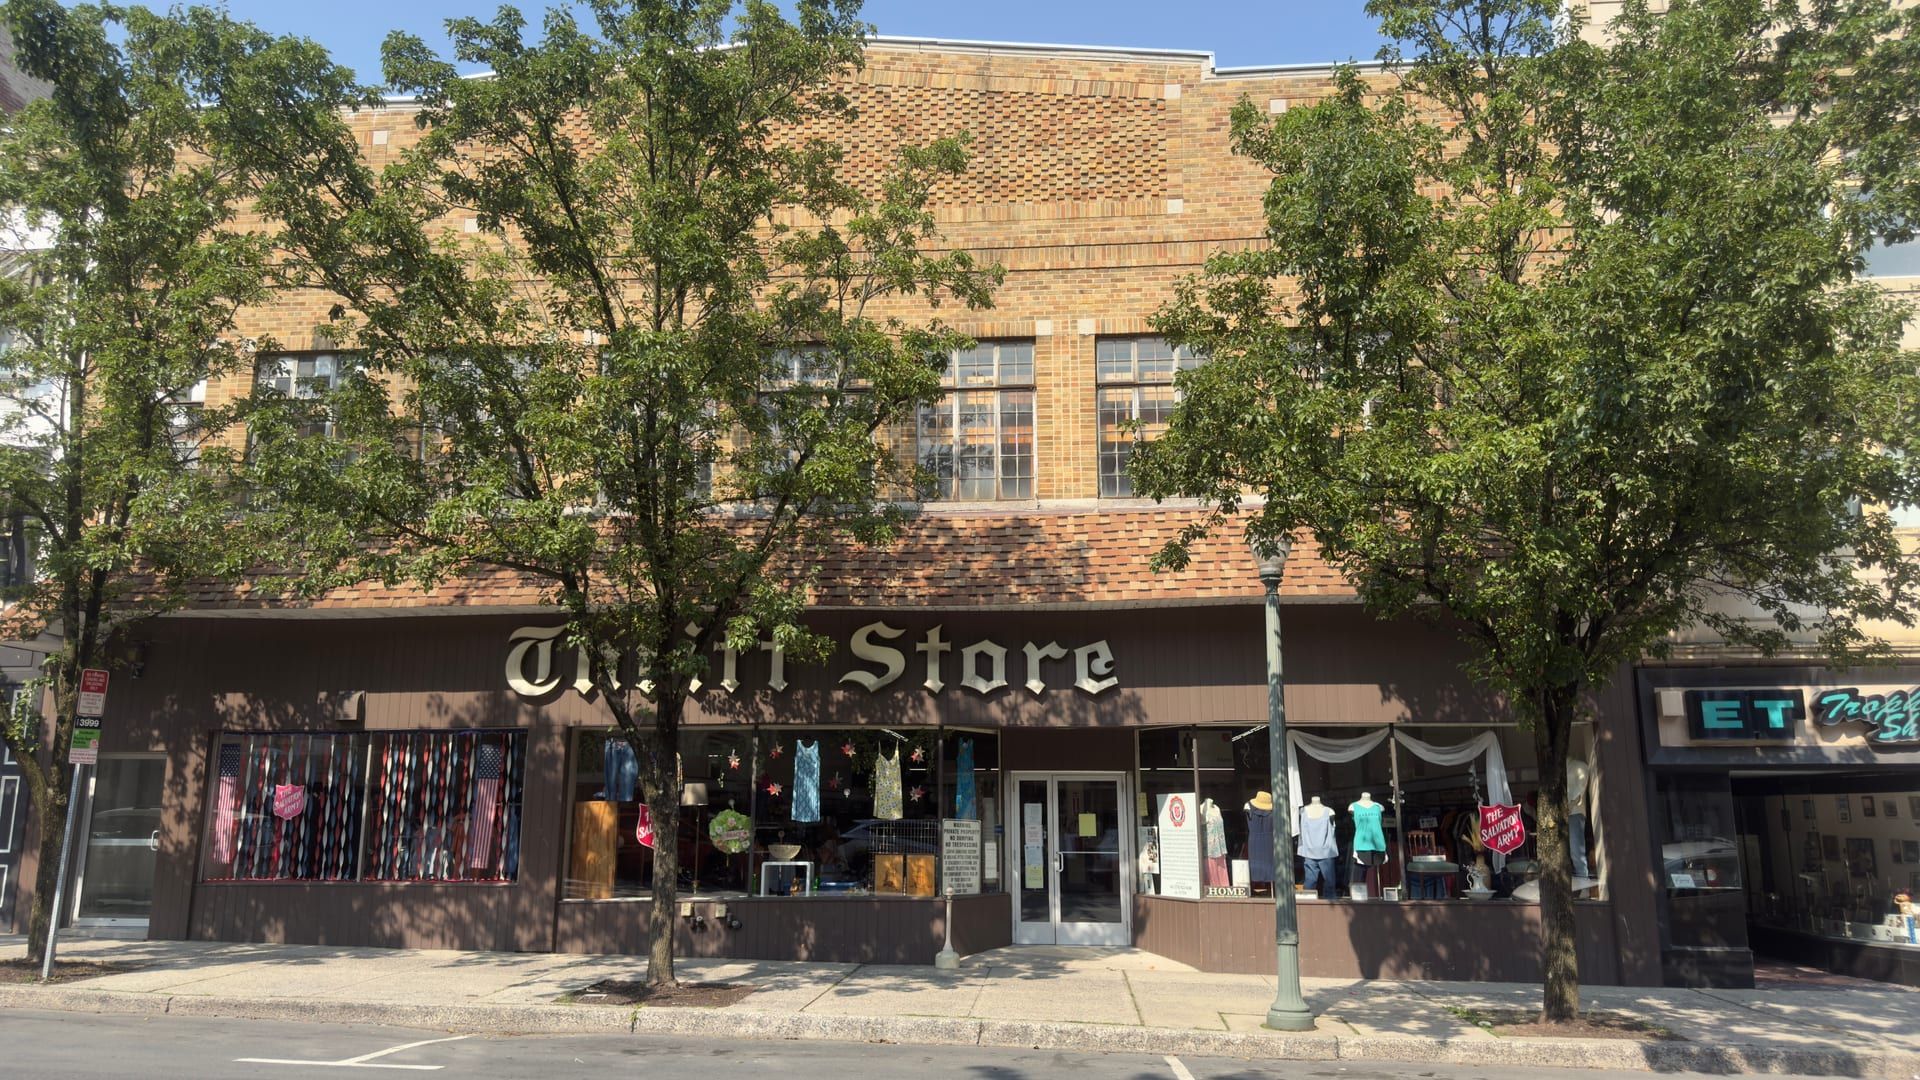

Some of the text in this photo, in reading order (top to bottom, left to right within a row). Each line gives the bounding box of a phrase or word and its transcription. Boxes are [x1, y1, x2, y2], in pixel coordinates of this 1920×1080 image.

[840, 620, 1118, 696] Store
[1701, 700, 1793, 729] ET
[1481, 811, 1518, 841] SALVATION
[1486, 808, 1503, 824] THE
[1497, 825, 1519, 848] ARMY
[1208, 887, 1246, 896] HOME
